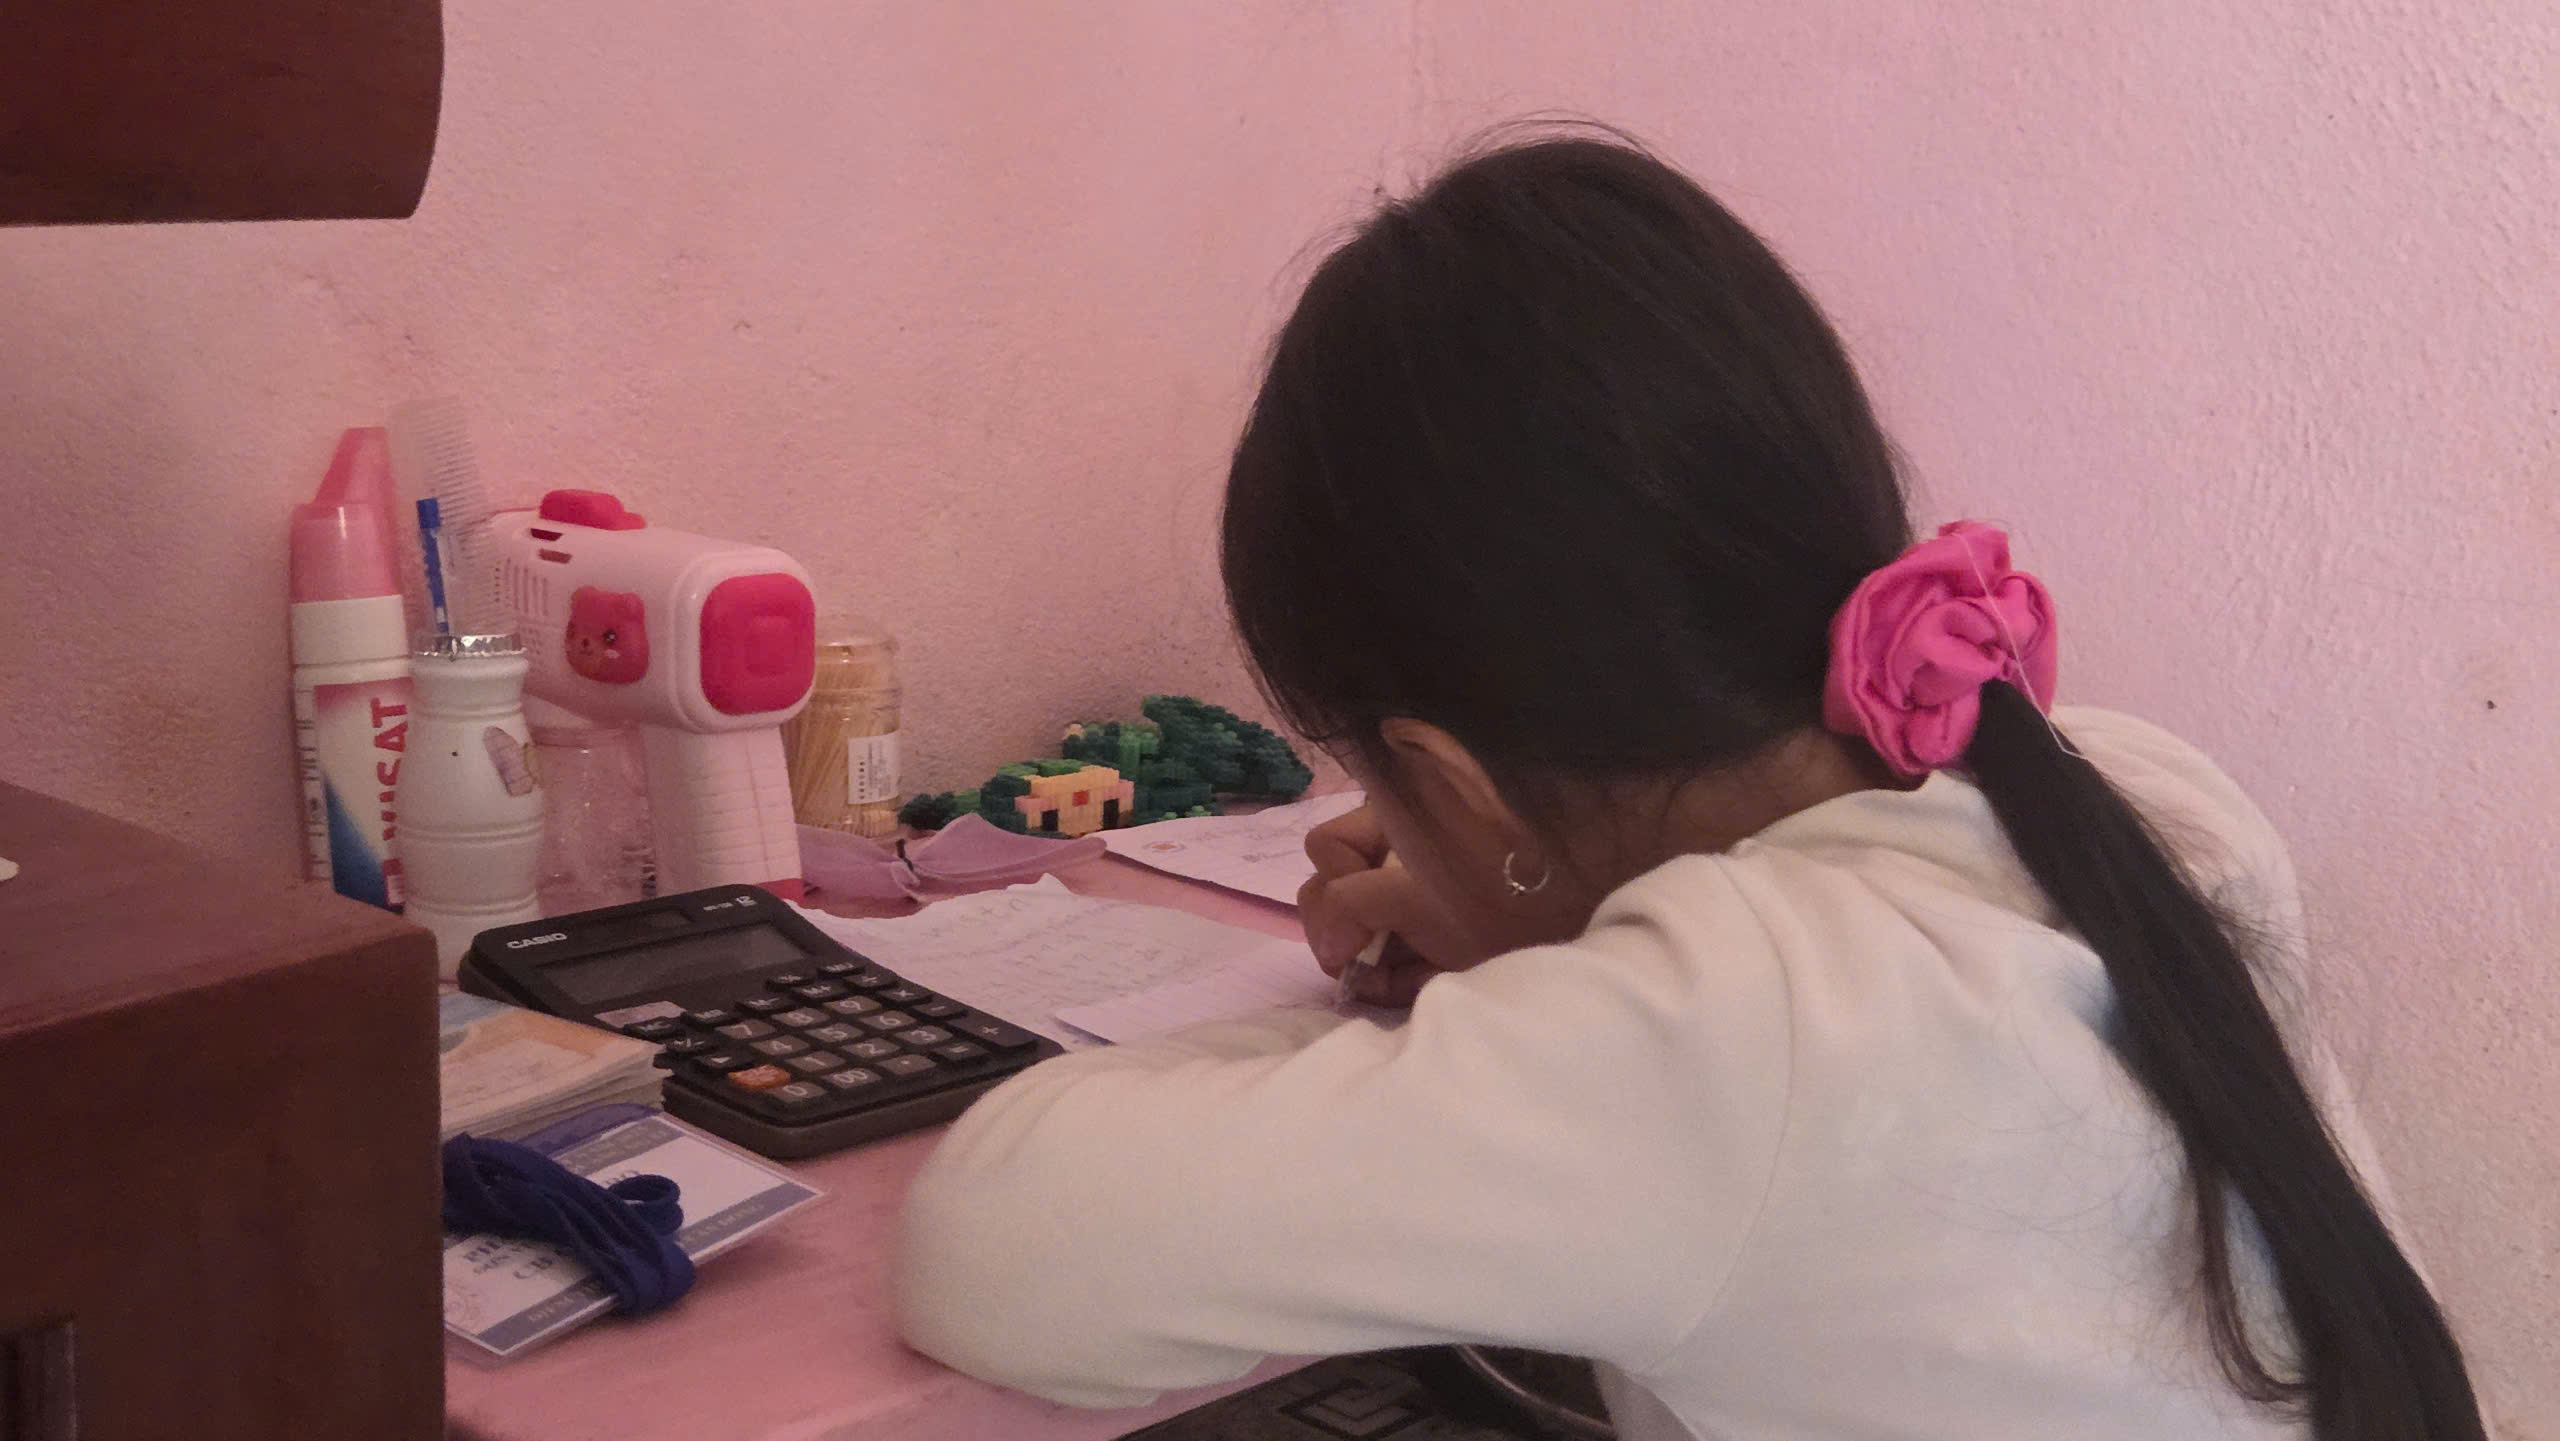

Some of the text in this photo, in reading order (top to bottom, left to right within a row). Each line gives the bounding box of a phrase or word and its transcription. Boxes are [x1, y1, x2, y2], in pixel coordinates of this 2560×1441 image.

[506, 932, 568, 949] CASIO
[839, 999, 862, 1011] 9
[879, 1015, 901, 1026] 6
[730, 1023, 753, 1036] 7
[821, 1027, 848, 1041] 5
[911, 1029, 937, 1042] 3
[771, 1040, 793, 1051] 4
[857, 1043, 885, 1055] 2
[804, 1055, 827, 1067] 1
[832, 1069, 868, 1084] 00
[782, 1084, 809, 1097] 0
